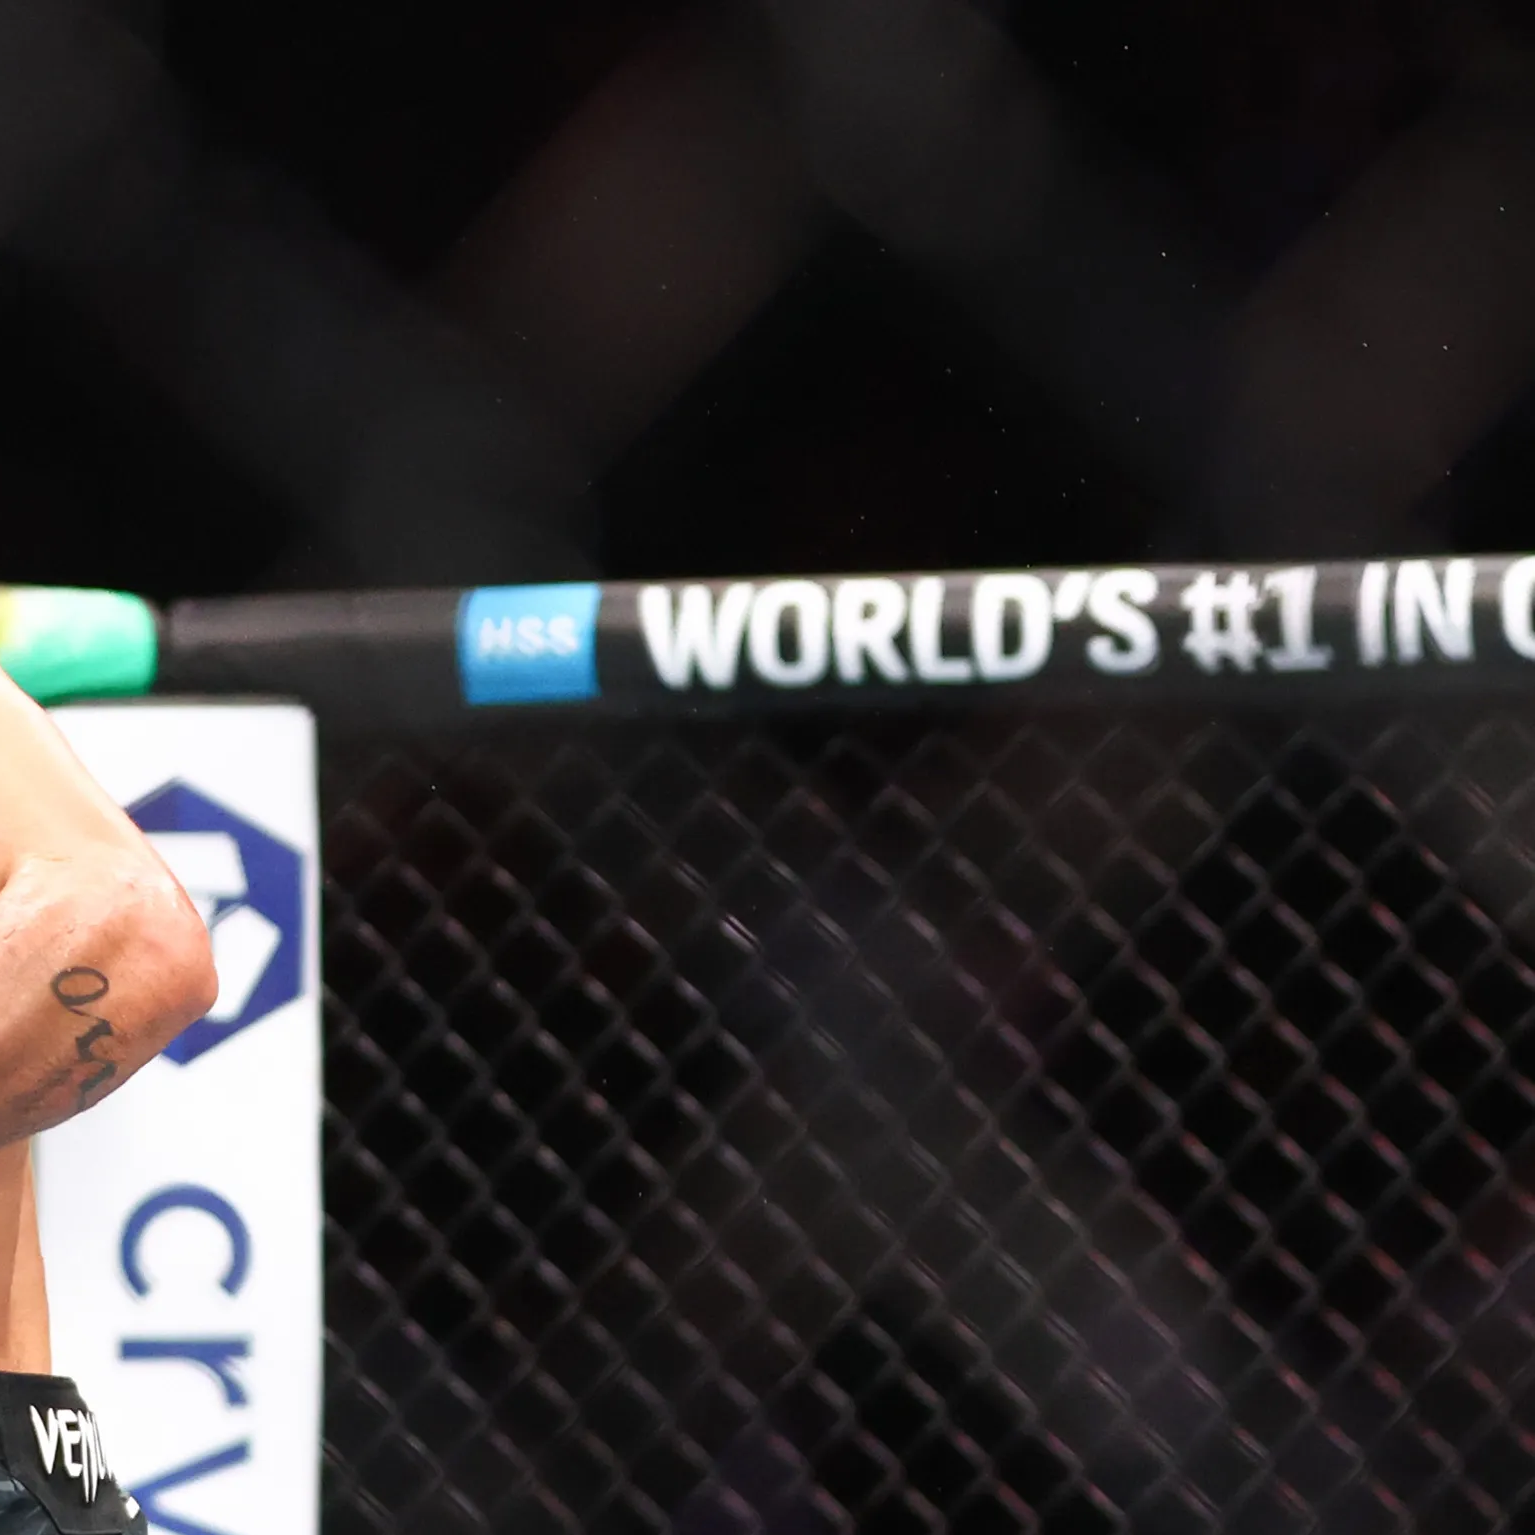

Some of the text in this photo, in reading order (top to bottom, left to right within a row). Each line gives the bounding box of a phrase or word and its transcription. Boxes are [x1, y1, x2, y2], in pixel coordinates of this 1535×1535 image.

[476, 615, 579, 660] HSS
[638, 567, 1161, 690] WORLD'S
[1182, 564, 1333, 673] #1
[1358, 557, 1477, 668] IN
